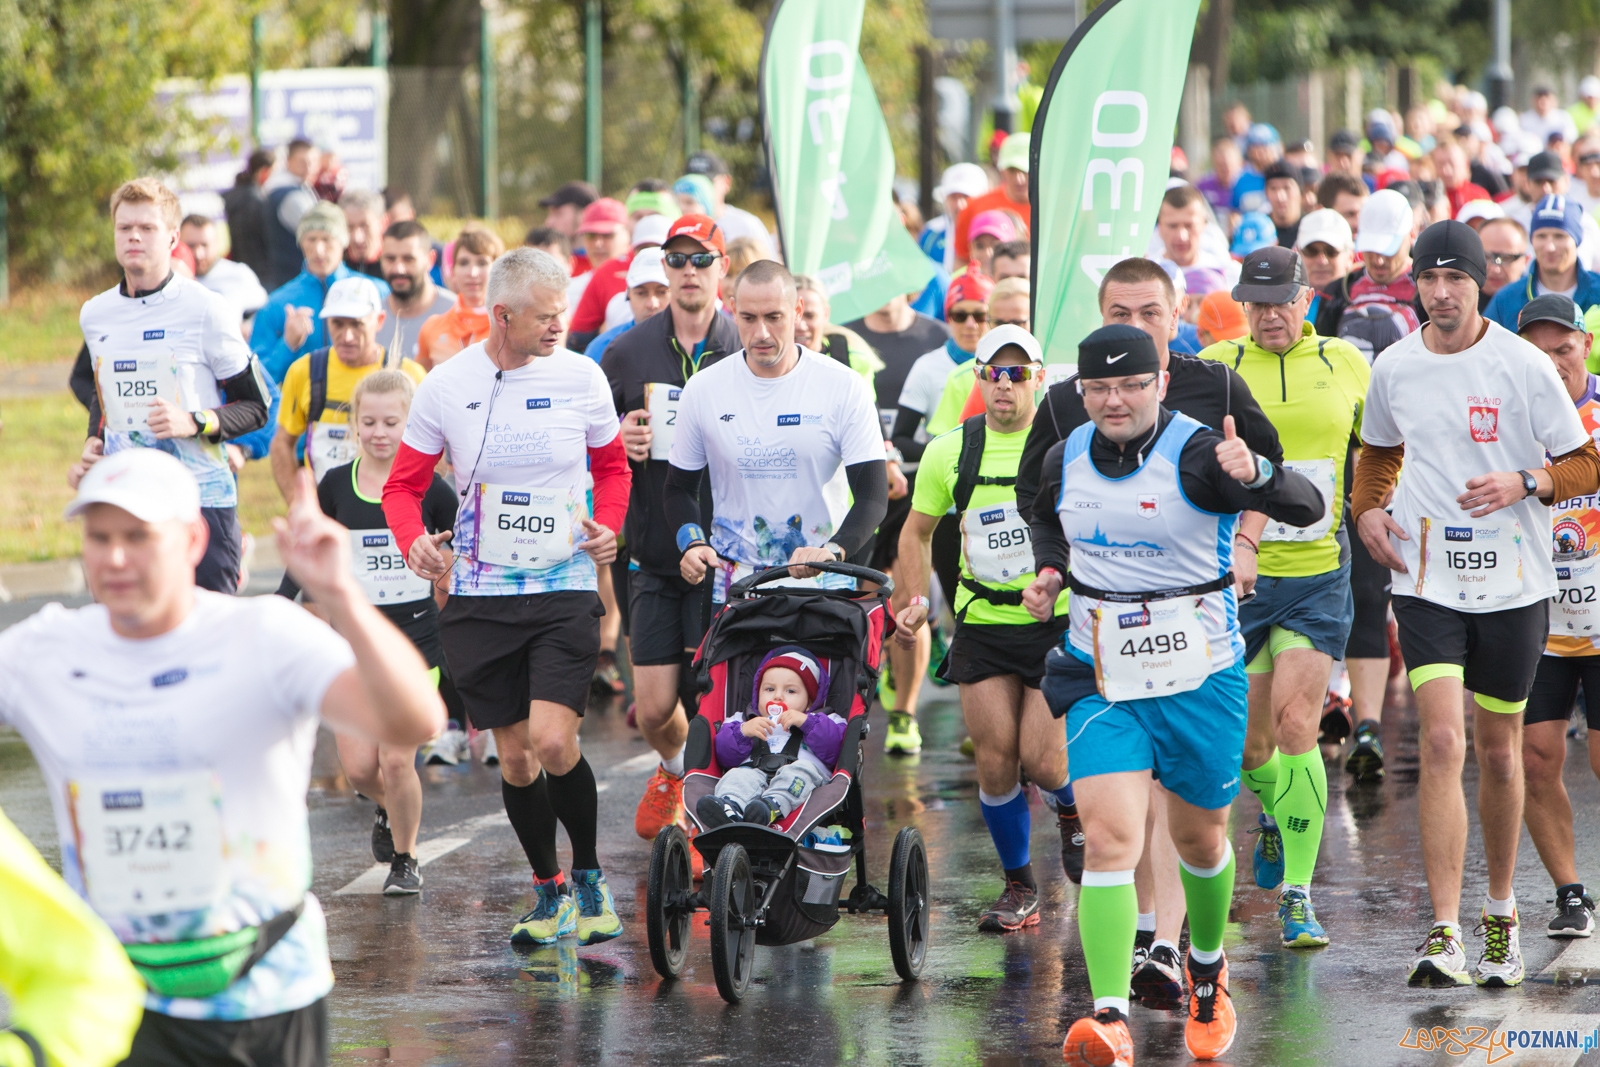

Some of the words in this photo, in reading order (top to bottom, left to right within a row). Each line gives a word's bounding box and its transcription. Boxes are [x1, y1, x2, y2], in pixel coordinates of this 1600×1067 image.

[115, 380, 158, 397] 1285
[1466, 395, 1502, 406] POLAND
[494, 431, 550, 443] ODWAGA
[737, 436, 761, 446] SIŁA
[486, 440, 553, 454] SZYBKOŚĆ
[744, 447, 797, 457] ODWAGA
[736, 456, 797, 467] SZYBKOŚĆ
[1552, 493, 1600, 509] ORT
[498, 513, 555, 534] 6409
[513, 536, 538, 545] Jacek
[998, 550, 1026, 561] Marcin
[1125, 550, 1165, 558] BIEGA
[367, 554, 406, 570] 393
[1446, 550, 1497, 570] 1699
[374, 574, 407, 582] Malwina
[1457, 574, 1486, 582] Michał
[1563, 607, 1591, 615] Marcin
[1120, 631, 1188, 657] 4498
[1142, 659, 1172, 670] Paweł
[104, 820, 192, 856] 3742
